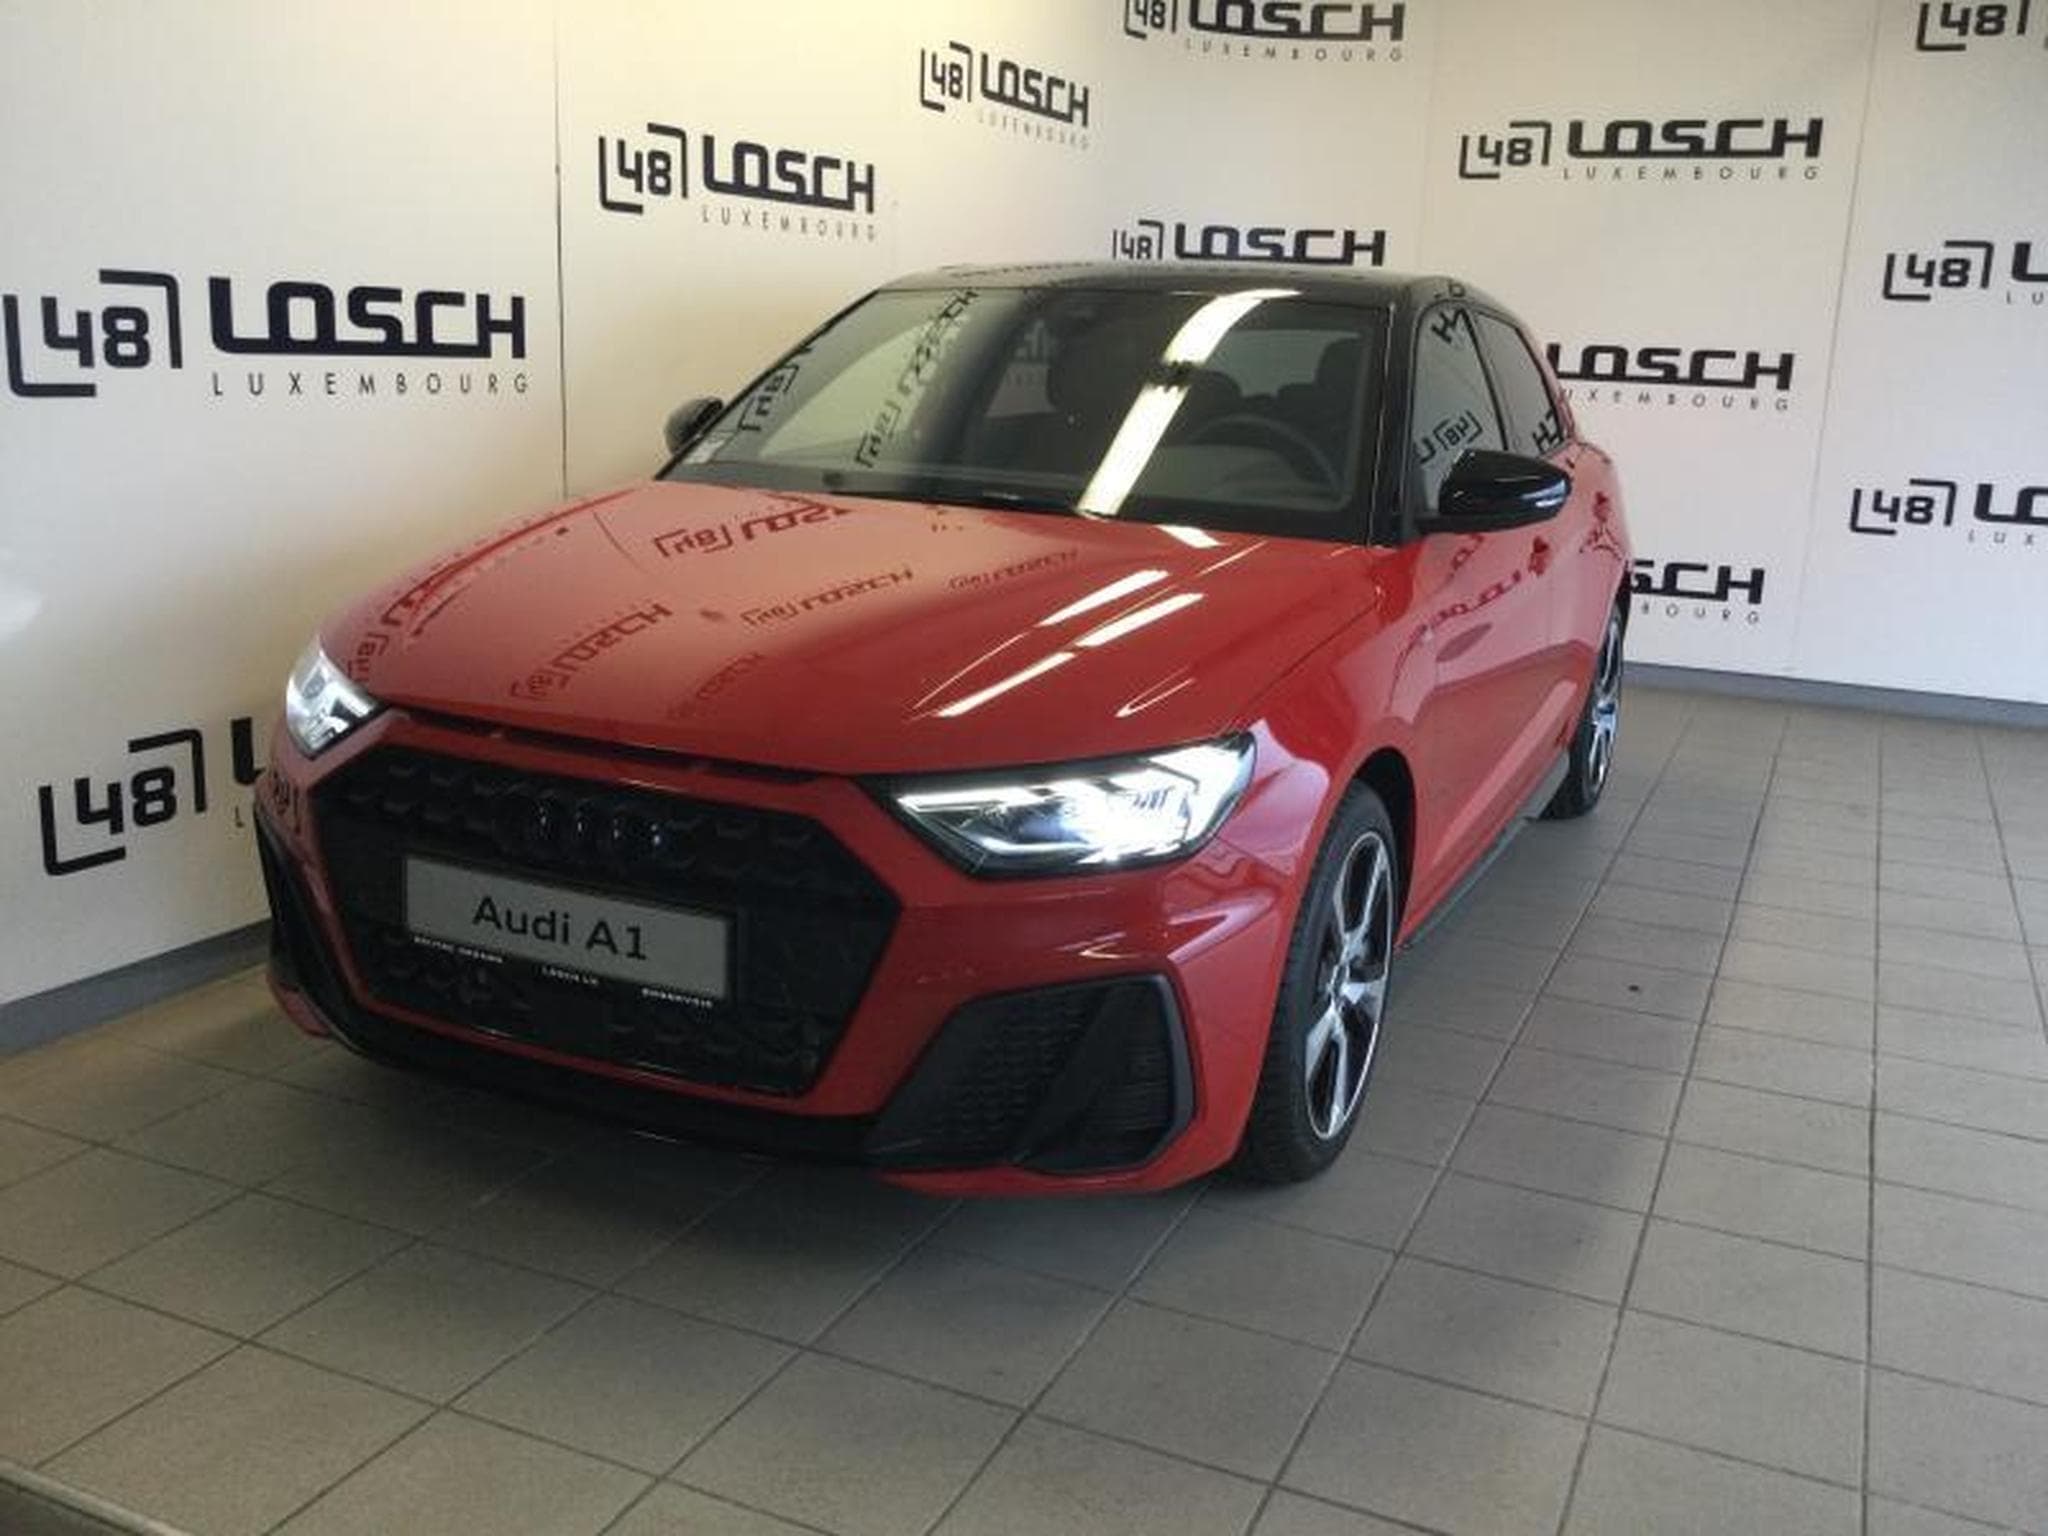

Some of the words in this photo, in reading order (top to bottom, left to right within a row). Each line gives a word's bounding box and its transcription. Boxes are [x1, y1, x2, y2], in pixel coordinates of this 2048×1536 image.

[1189, 0, 1405, 41] LOSCH
[981, 52, 1089, 128] LOSCH
[1568, 117, 1823, 158] LOSCH
[702, 134, 875, 213] LOSCH
[1563, 165, 1819, 181] LUXEMBOURG
[1174, 223, 1386, 266] LOSCH
[208, 277, 526, 359] LOSCH
[211, 371, 529, 396] LUXEMBOURG
[1547, 343, 1794, 390] LOSCH
[472, 895, 570, 946] Audi
[586, 919, 648, 962] A1
